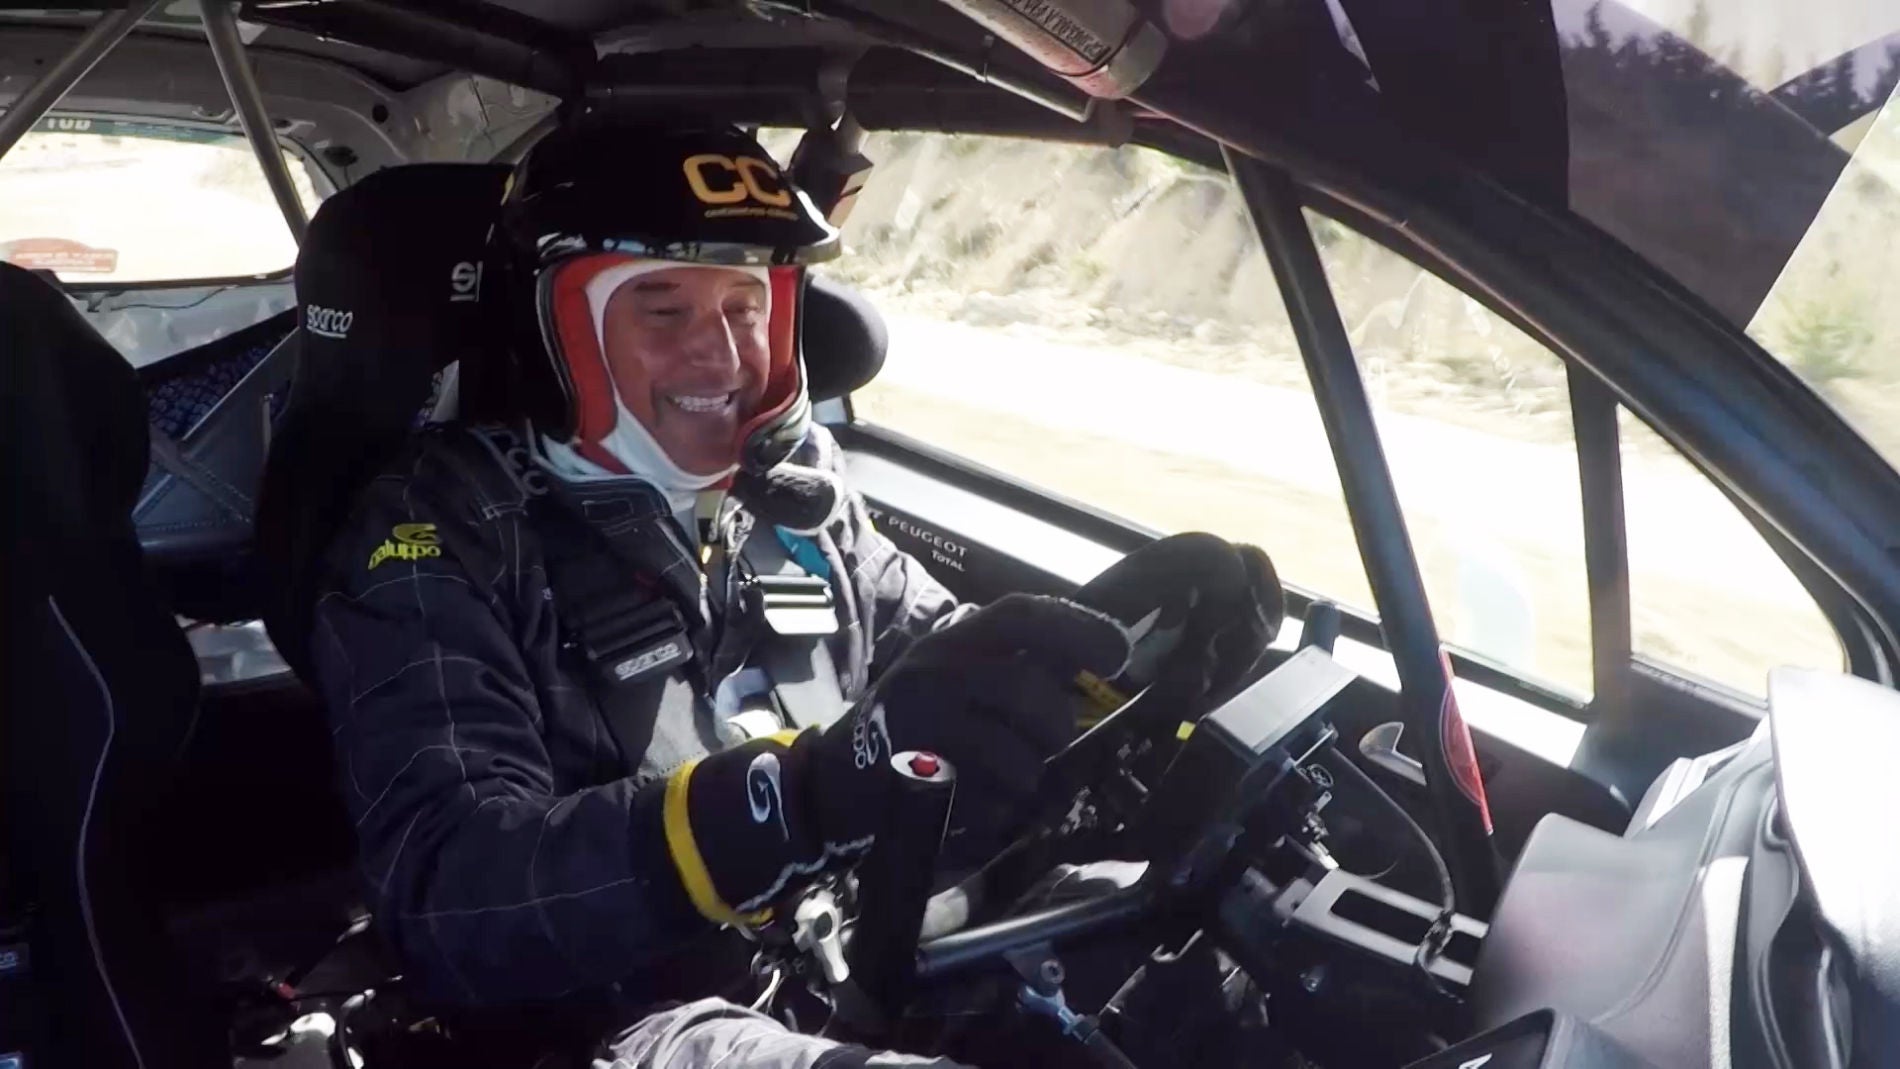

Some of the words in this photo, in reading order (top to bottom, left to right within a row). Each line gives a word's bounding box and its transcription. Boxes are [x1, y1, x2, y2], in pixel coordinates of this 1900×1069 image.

[683, 154, 791, 207] CC
[888, 515, 967, 557] PEUGEOT
[931, 549, 966, 572] TOTAL
